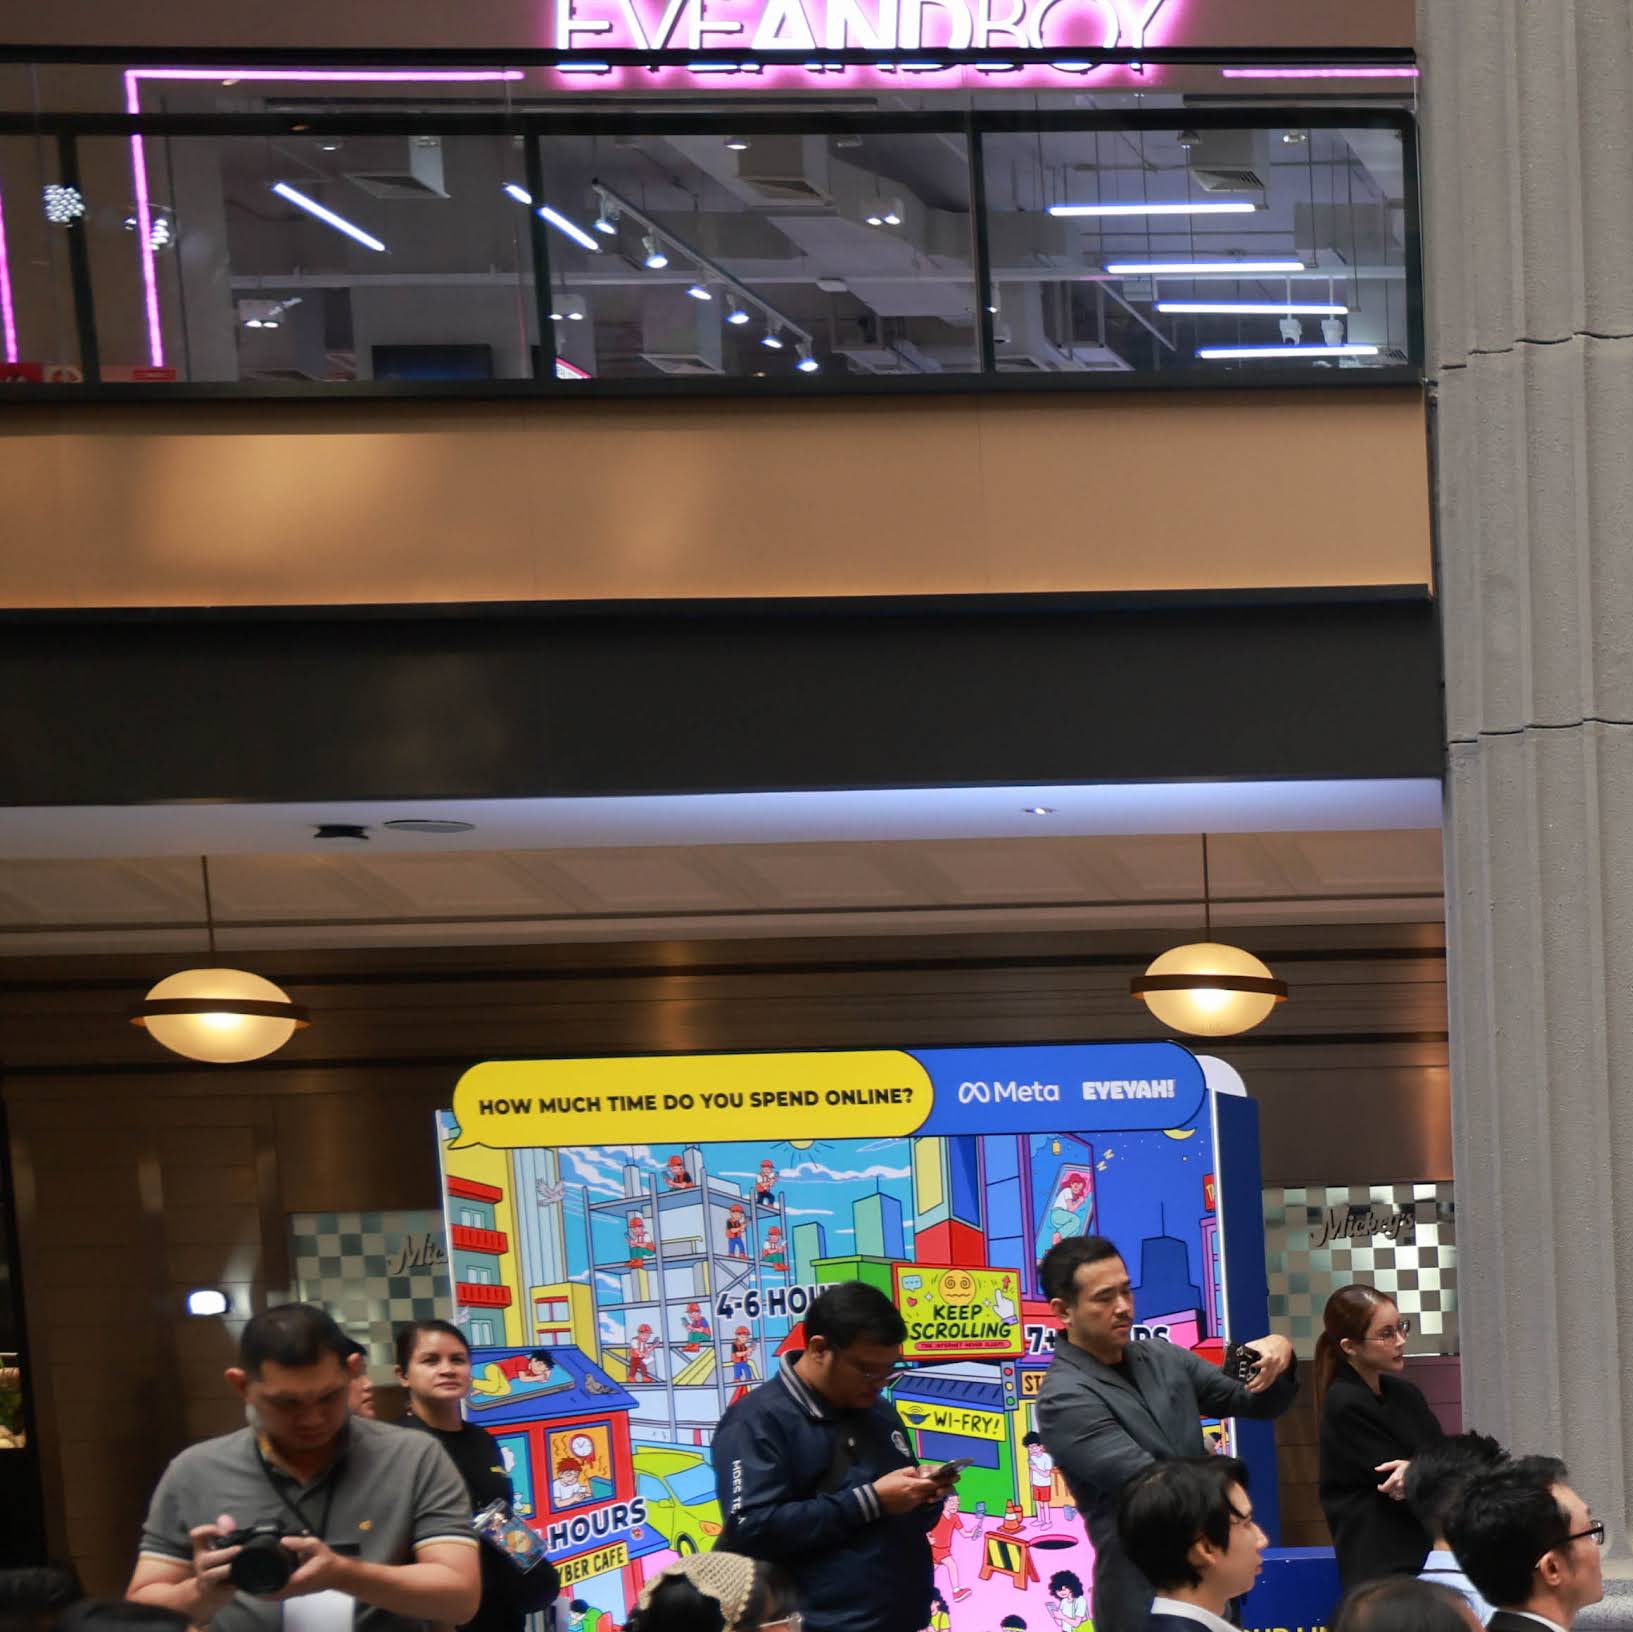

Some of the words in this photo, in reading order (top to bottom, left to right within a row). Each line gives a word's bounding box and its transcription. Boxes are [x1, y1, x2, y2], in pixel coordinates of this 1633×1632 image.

[479, 1098, 533, 1116] HOW
[539, 1096, 600, 1114] MUCH
[606, 1094, 657, 1112] TIME
[663, 1093, 695, 1110] DO
[699, 1092, 744, 1109] YOU
[749, 1090, 819, 1108] SPEND
[825, 1087, 914, 1106] ONLINE?
[994, 1081, 1060, 1102] Meta
[1082, 1078, 1176, 1100] EYEYAH!
[1310, 1204, 1416, 1247] Mickey's
[386, 1232, 449, 1276] Mic
[717, 1289, 761, 1320] 4-6
[933, 1304, 983, 1320] KEEP
[910, 1322, 1011, 1340] SCROLLING
[933, 1410, 1000, 1435] WI-FRY!
[550, 1499, 647, 1549] HOURS
[557, 1562, 589, 1583] YBER
[594, 1546, 624, 1571] CAFE
